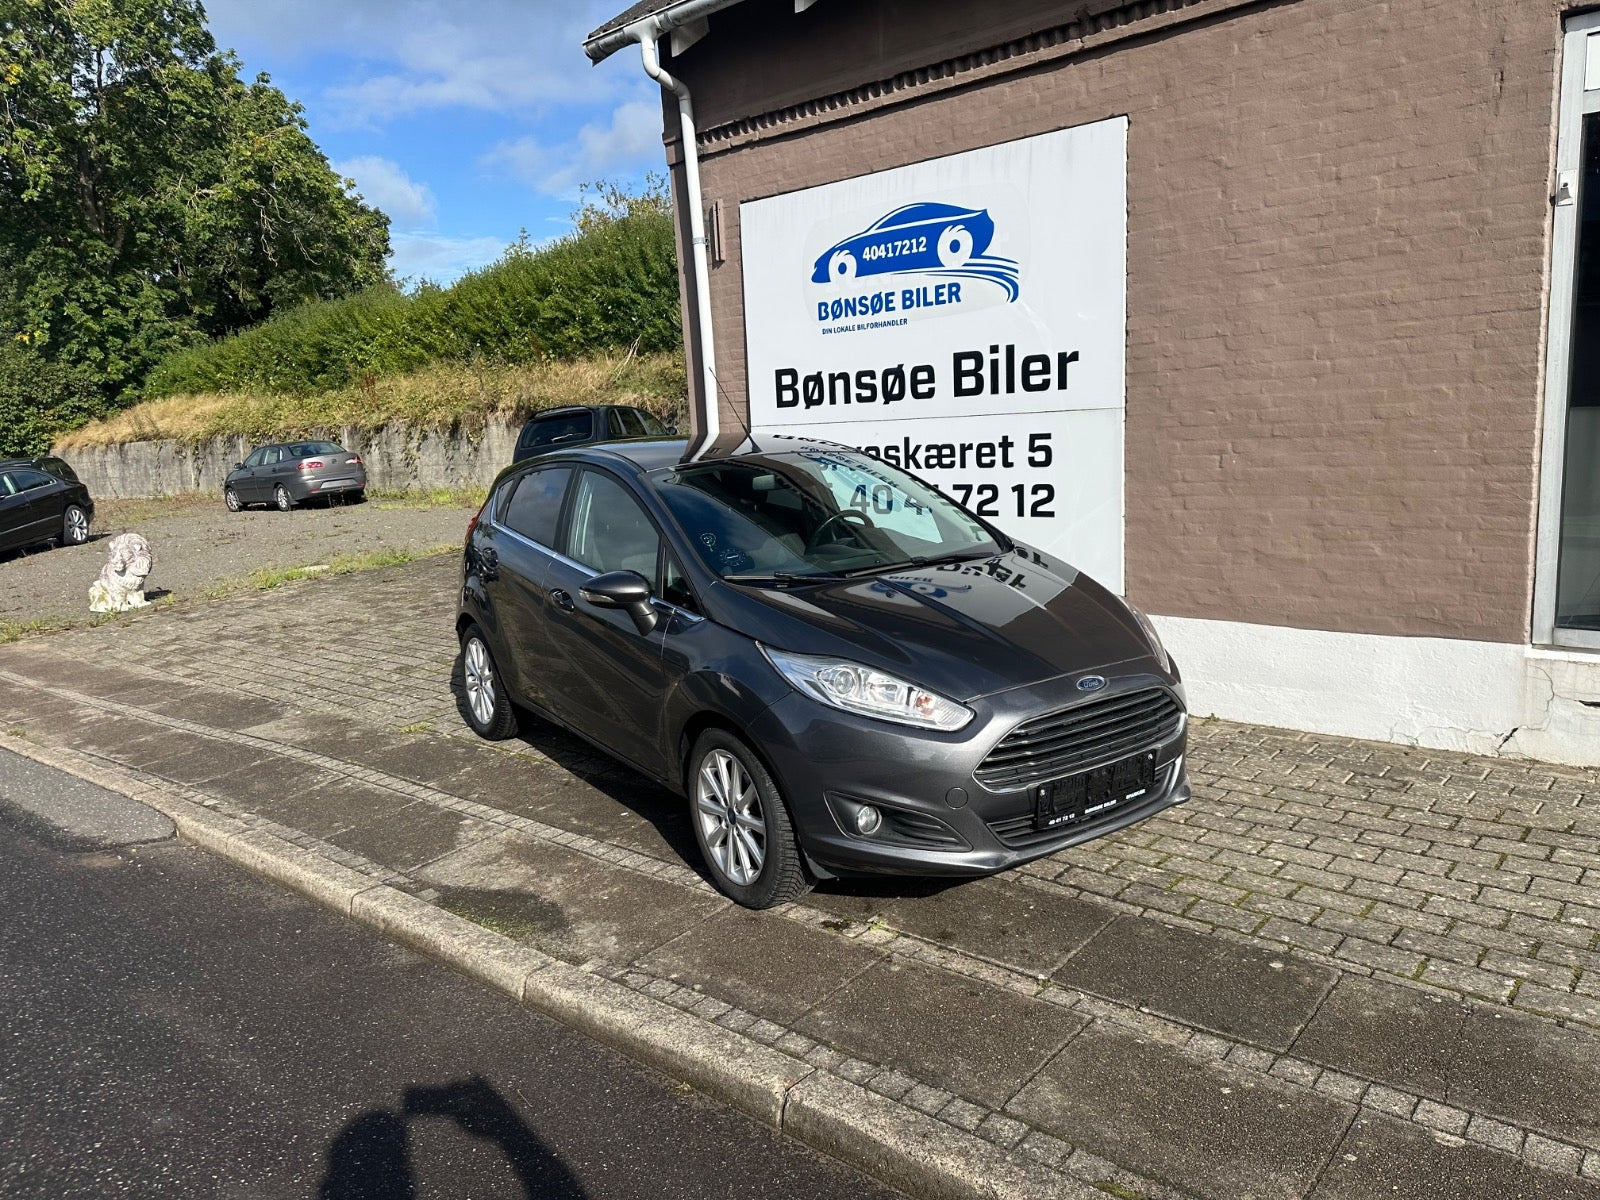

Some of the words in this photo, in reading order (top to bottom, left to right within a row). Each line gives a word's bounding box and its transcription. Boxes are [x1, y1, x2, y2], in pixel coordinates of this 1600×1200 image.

[863, 236, 927, 262] 40417212
[817, 291, 896, 321] BØNSØE
[901, 282, 961, 310] BILER
[822, 327, 833, 335] DIN
[833, 324, 856, 334] LOKALE
[857, 318, 908, 331] BILFORHANDLER
[774, 363, 936, 409] Bønsøe
[953, 344, 1079, 397] Biler
[1028, 433, 1053, 468] 5
[850, 484, 893, 515] 40
[952, 484, 999, 516] 72
[1012, 483, 1055, 518] 12
